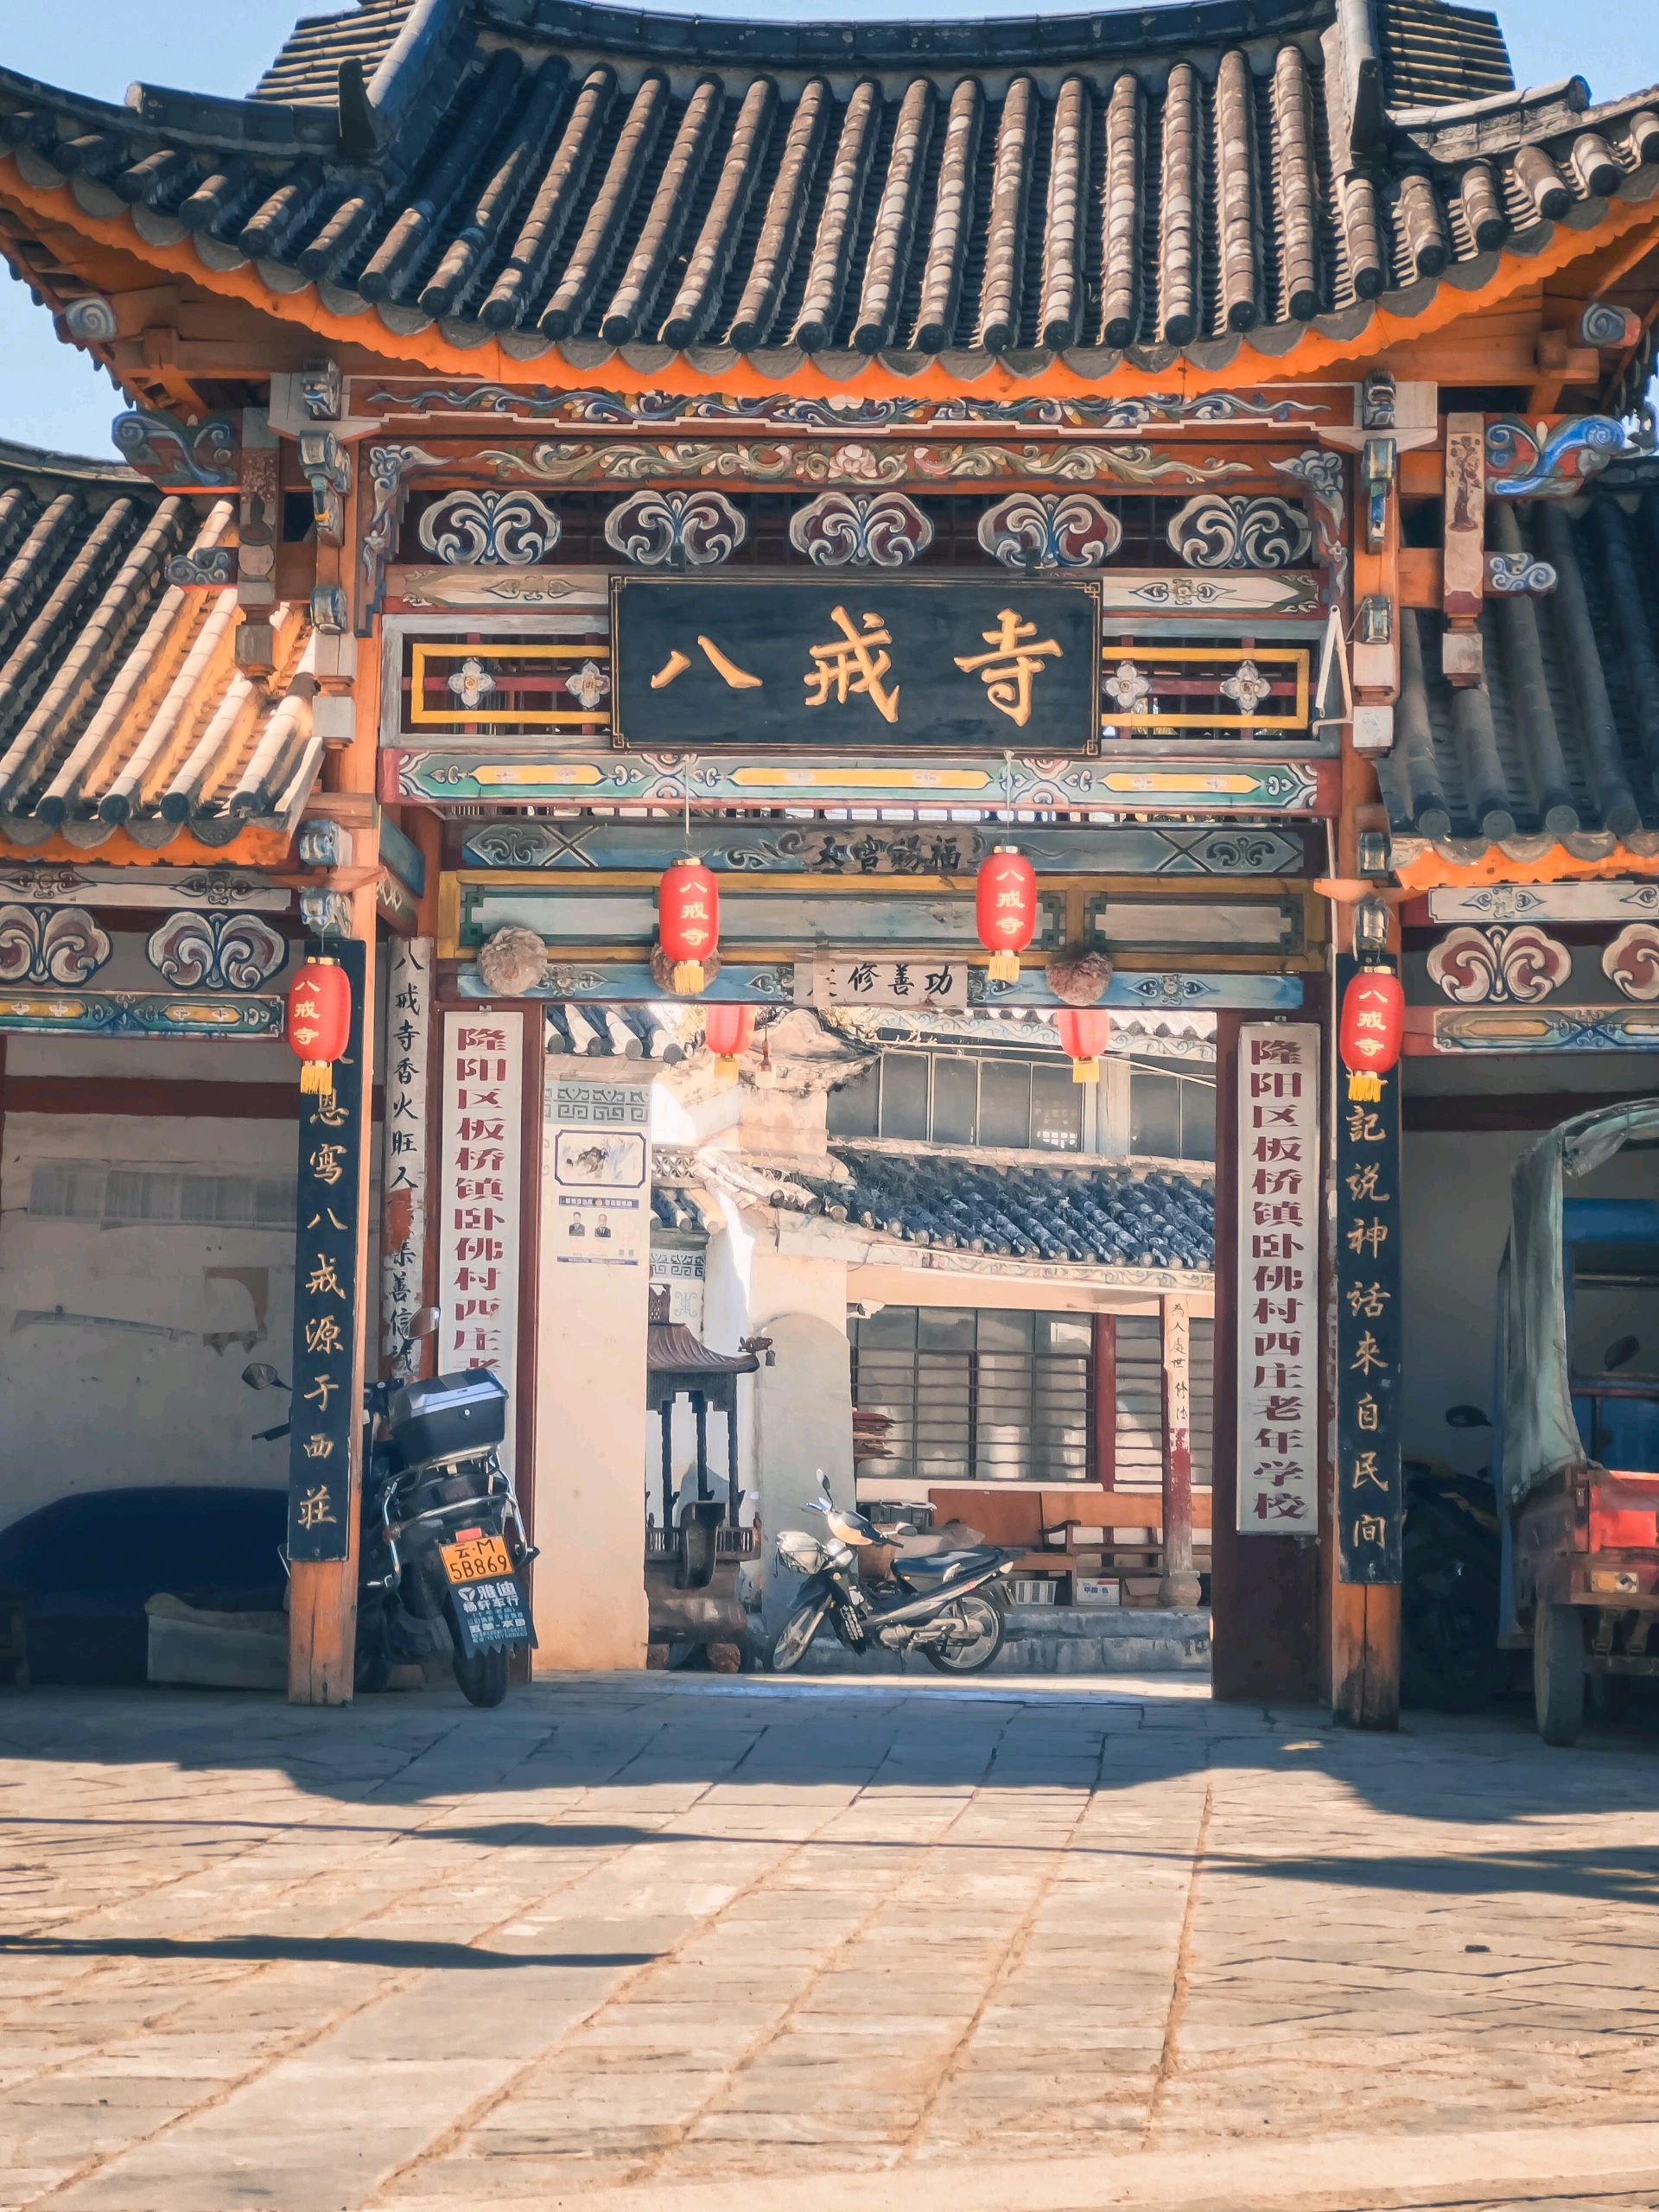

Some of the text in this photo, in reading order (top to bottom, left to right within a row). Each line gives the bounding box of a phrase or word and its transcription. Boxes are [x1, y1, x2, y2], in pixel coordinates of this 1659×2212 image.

[650, 605, 1064, 727] 八戒寺
[679, 881, 709, 946] 八戒寺
[995, 870, 1025, 935] 八戒寺
[294, 980, 321, 1045] 八戒寺
[1354, 989, 1389, 1057] 八戒寺
[1252, 1039, 1306, 1520] 隆阳区板桥镇卧佛村西庄老年学校
[450, 1554, 507, 1580] 5B869
[477, 1580, 517, 1600] 雅迪
